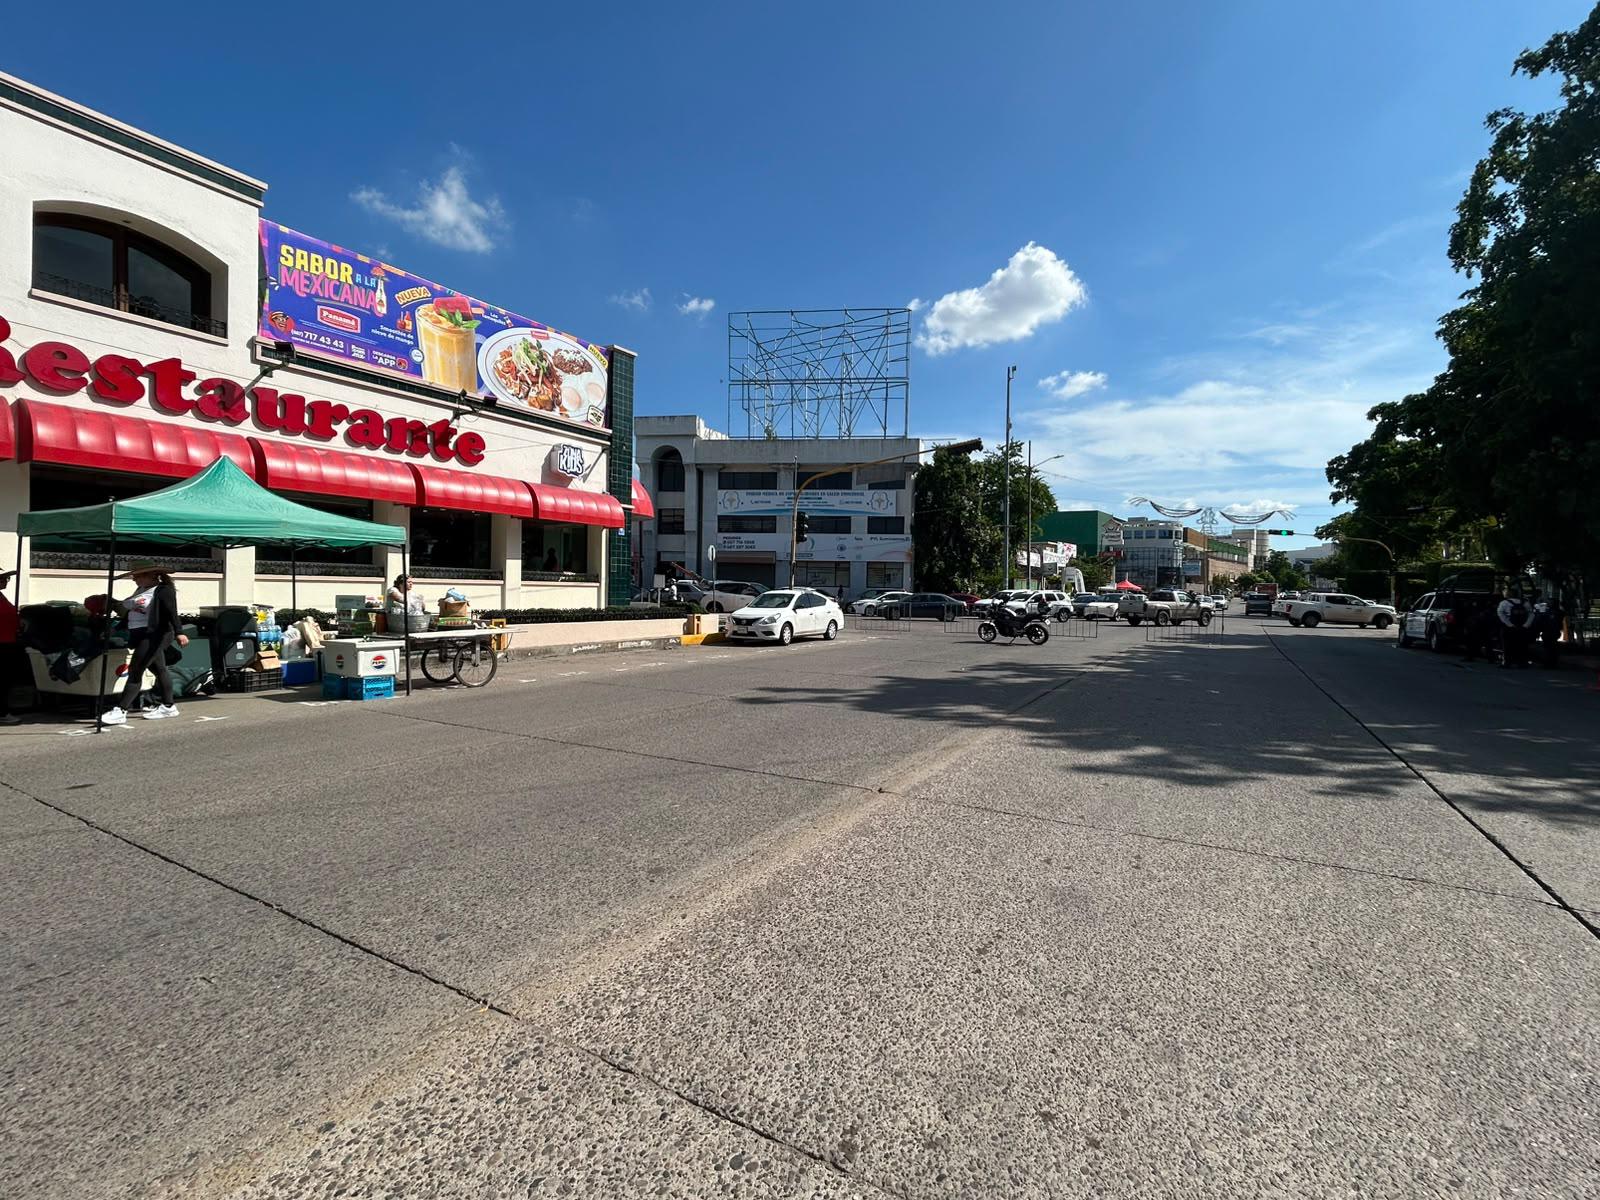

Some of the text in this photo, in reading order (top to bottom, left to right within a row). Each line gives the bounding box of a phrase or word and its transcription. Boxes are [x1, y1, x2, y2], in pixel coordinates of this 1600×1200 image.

[280, 244, 353, 284] SABOR
[355, 273, 377, 289] A LA
[280, 264, 386, 318] MEXICANA
[396, 286, 430, 304] NUEVA
[322, 309, 356, 327] Panamá
[304, 331, 318, 340] 717
[319, 336, 332, 345] 43
[333, 340, 344, 349] 43
[378, 356, 396, 367] APP
[0, 315, 486, 466] estaurante
[559, 453, 583, 474] KIDS
